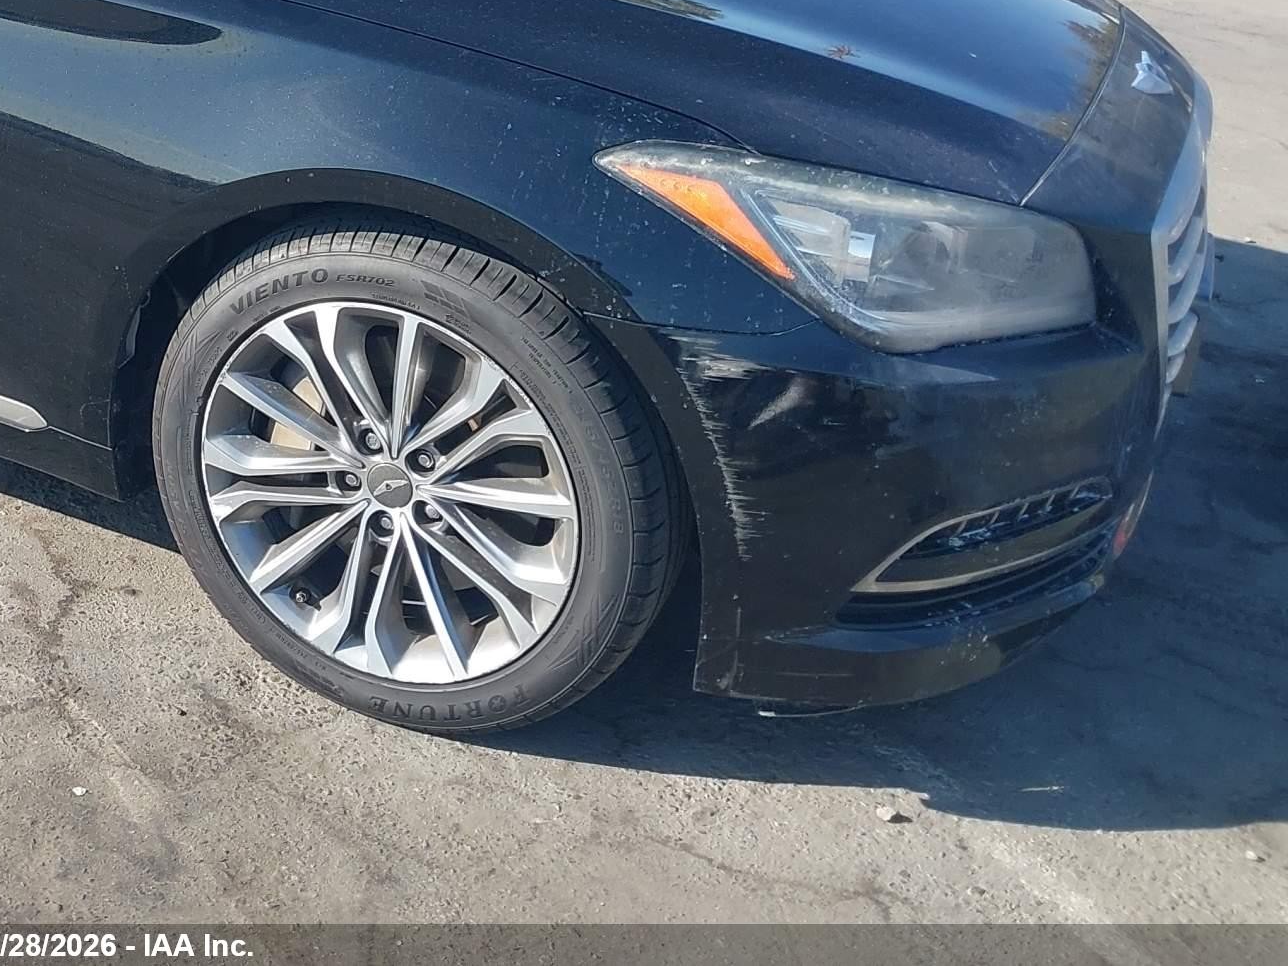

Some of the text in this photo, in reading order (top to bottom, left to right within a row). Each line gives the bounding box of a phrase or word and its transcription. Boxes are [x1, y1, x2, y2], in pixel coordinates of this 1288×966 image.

[229, 267, 395, 315] VIENTO FSR702
[367, 683, 531, 722] FORTUNE
